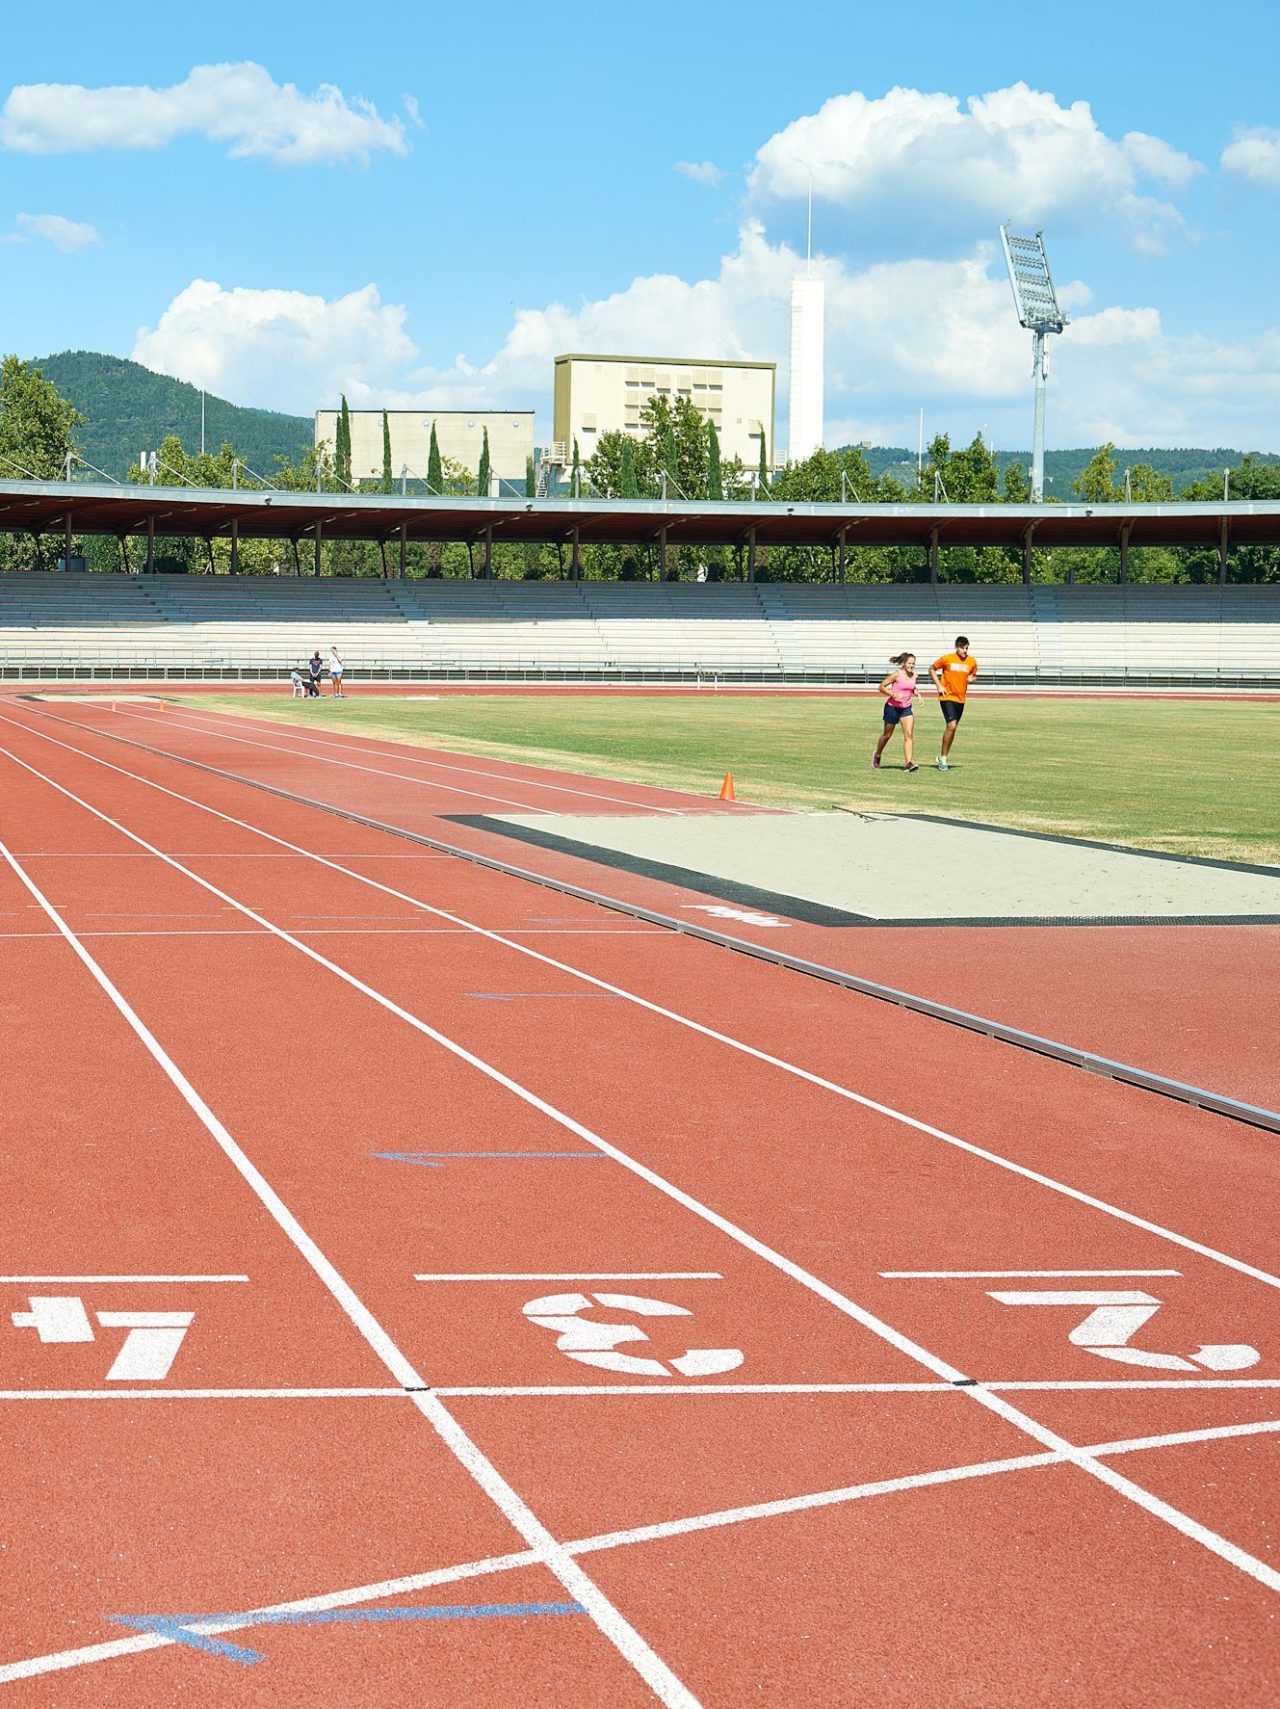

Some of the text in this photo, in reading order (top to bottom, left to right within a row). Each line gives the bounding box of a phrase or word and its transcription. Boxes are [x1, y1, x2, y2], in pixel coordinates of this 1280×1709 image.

[12, 1297, 194, 1380] 4
[523, 1293, 744, 1376] 3
[988, 1291, 1260, 1371] 2
